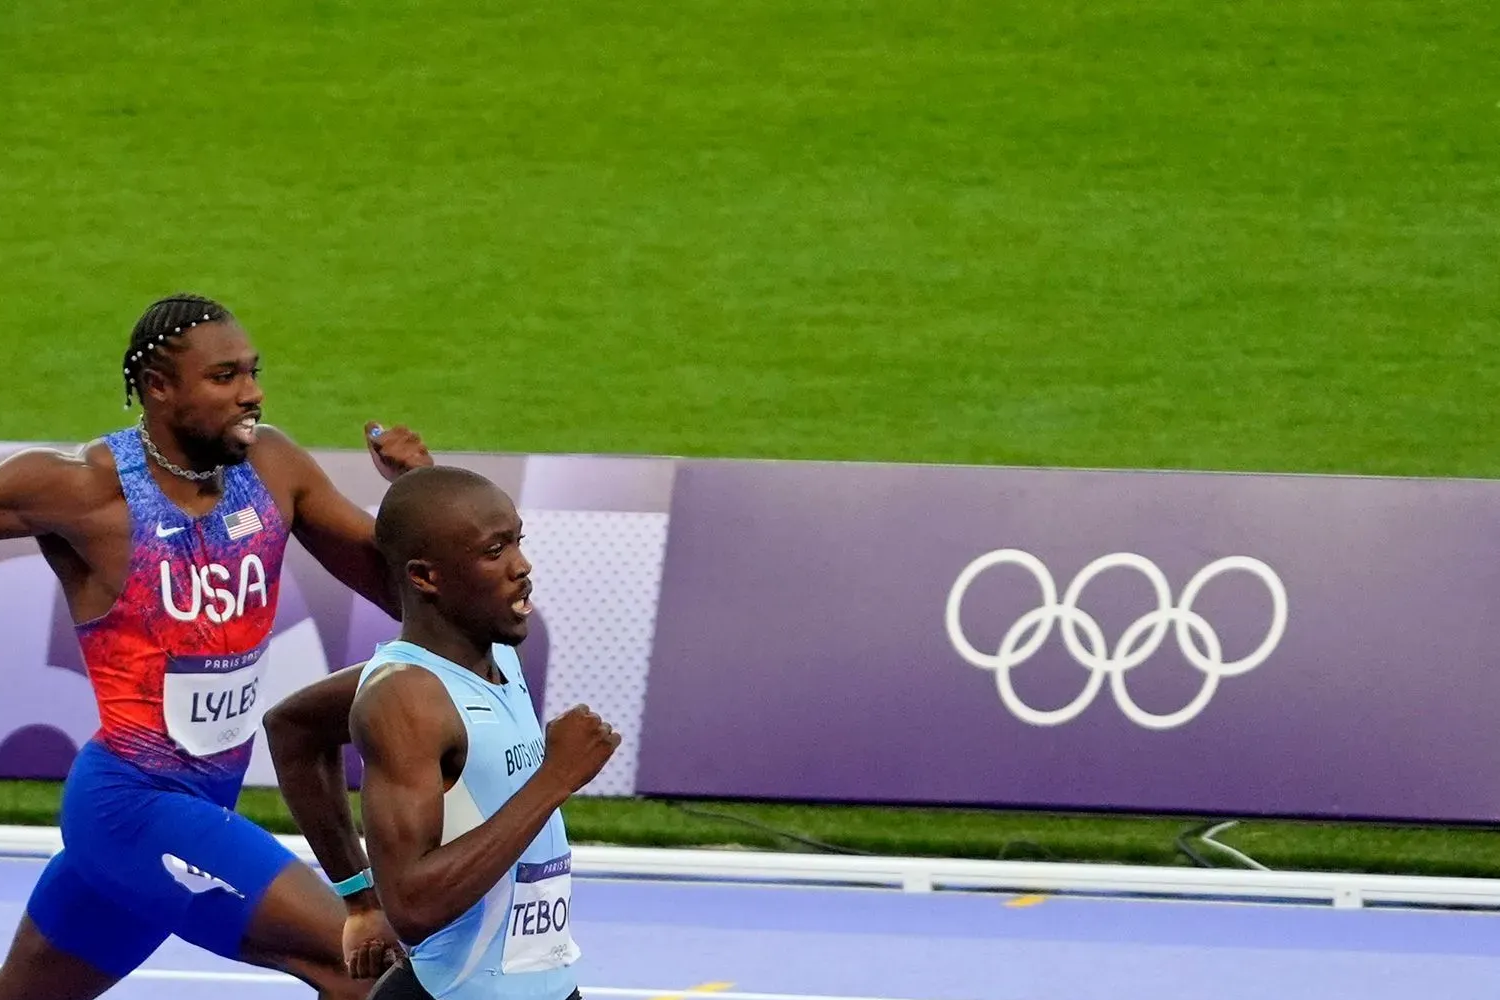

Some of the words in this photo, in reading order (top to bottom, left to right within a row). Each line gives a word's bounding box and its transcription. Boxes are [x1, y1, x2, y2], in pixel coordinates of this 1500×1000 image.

[160, 554, 268, 623] USA
[205, 658, 239, 669] PARIS
[543, 861, 563, 874] PARIS
[512, 896, 570, 936] TEBO
